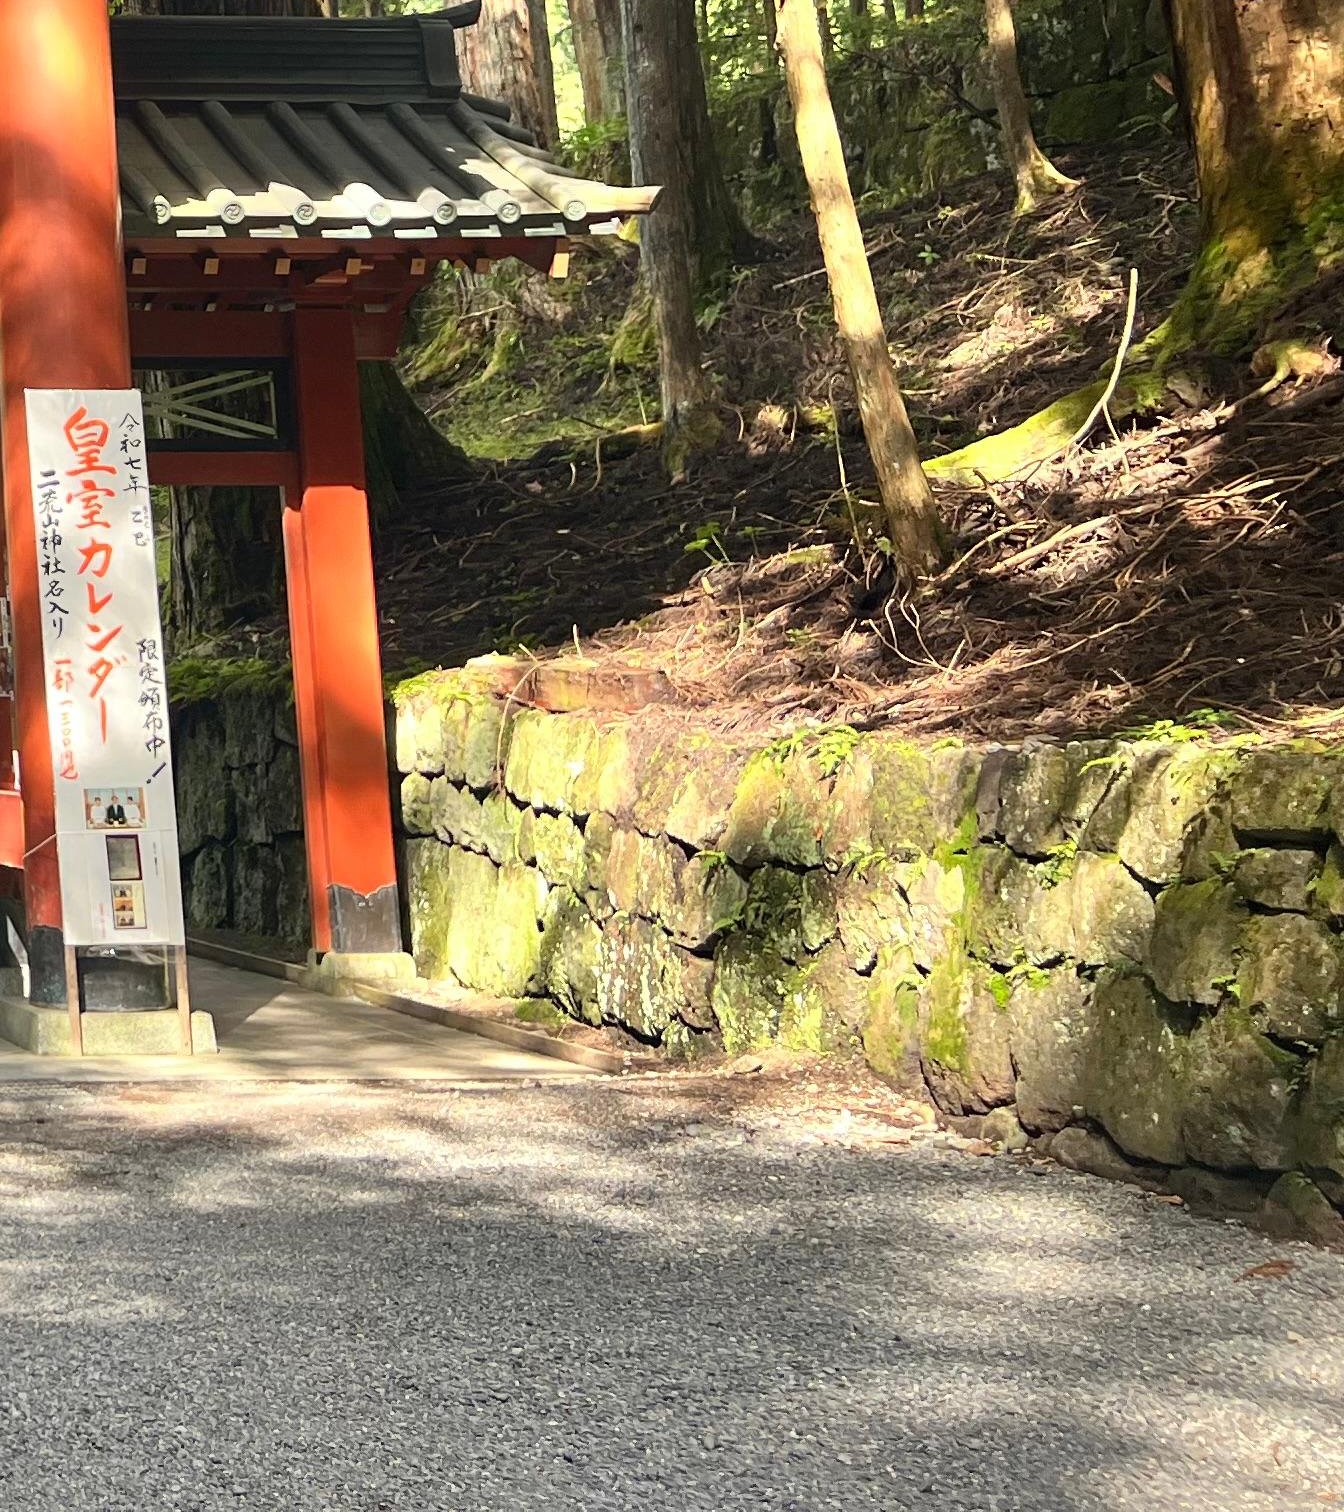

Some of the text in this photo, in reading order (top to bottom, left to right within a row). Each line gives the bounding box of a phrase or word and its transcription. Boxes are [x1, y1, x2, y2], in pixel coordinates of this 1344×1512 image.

[119, 413, 148, 495] 令和七年
[37, 469, 70, 640] 二荒山神社名入り
[64, 406, 127, 744] 皇室カレンダー
